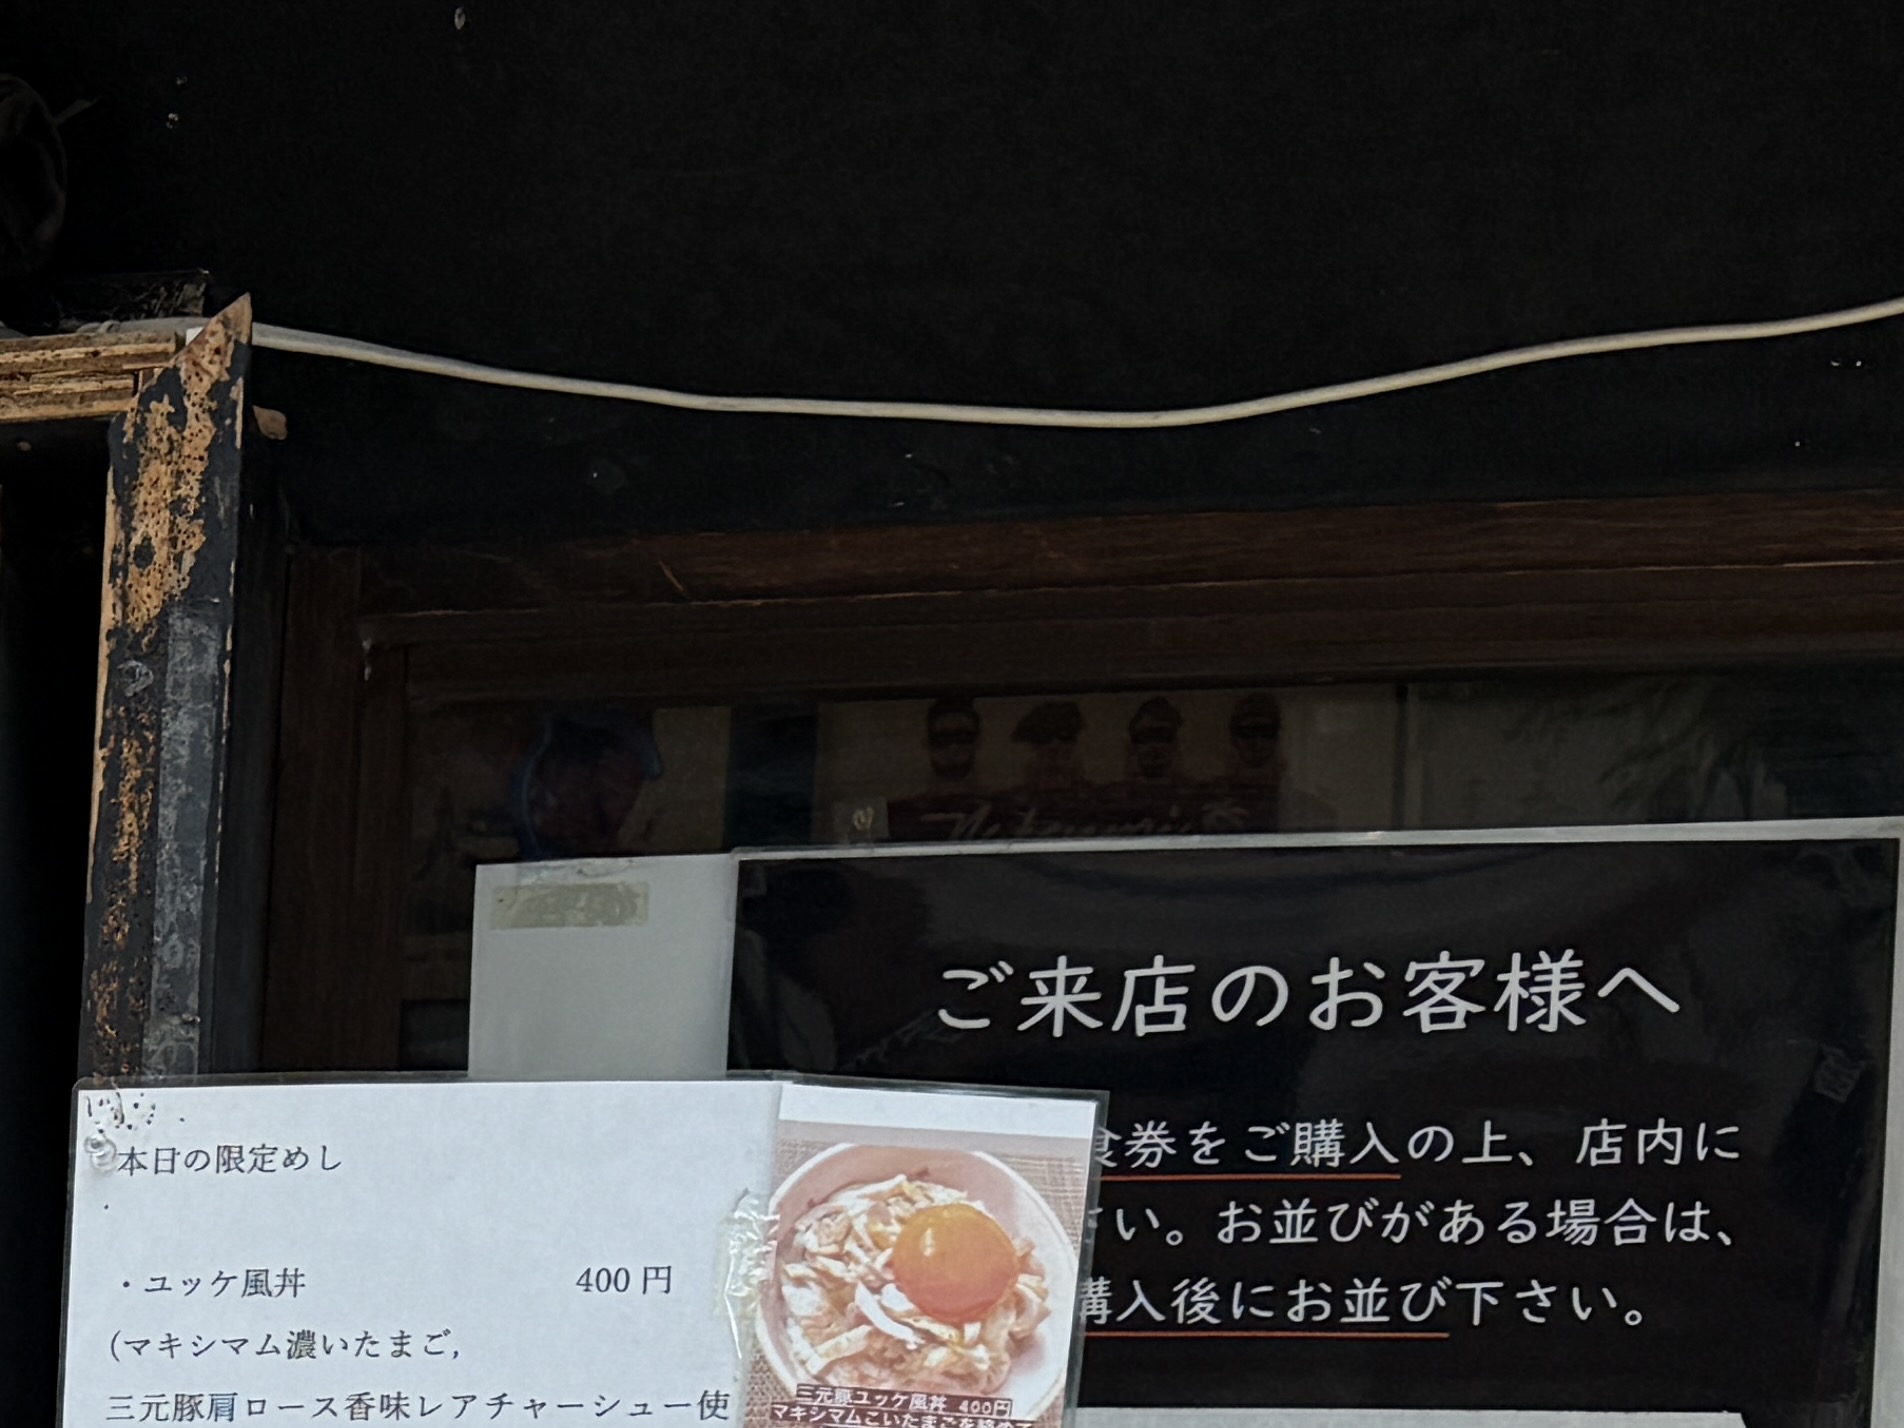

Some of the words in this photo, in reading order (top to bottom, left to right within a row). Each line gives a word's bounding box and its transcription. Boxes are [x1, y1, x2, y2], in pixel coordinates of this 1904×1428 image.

[935, 950, 1681, 1038] ご来店のお客様へ
[117, 1144, 342, 1175] 本日の限定めし
[105, 1391, 729, 1423] 三元豚肩ロース香味レアチャーシュー使
